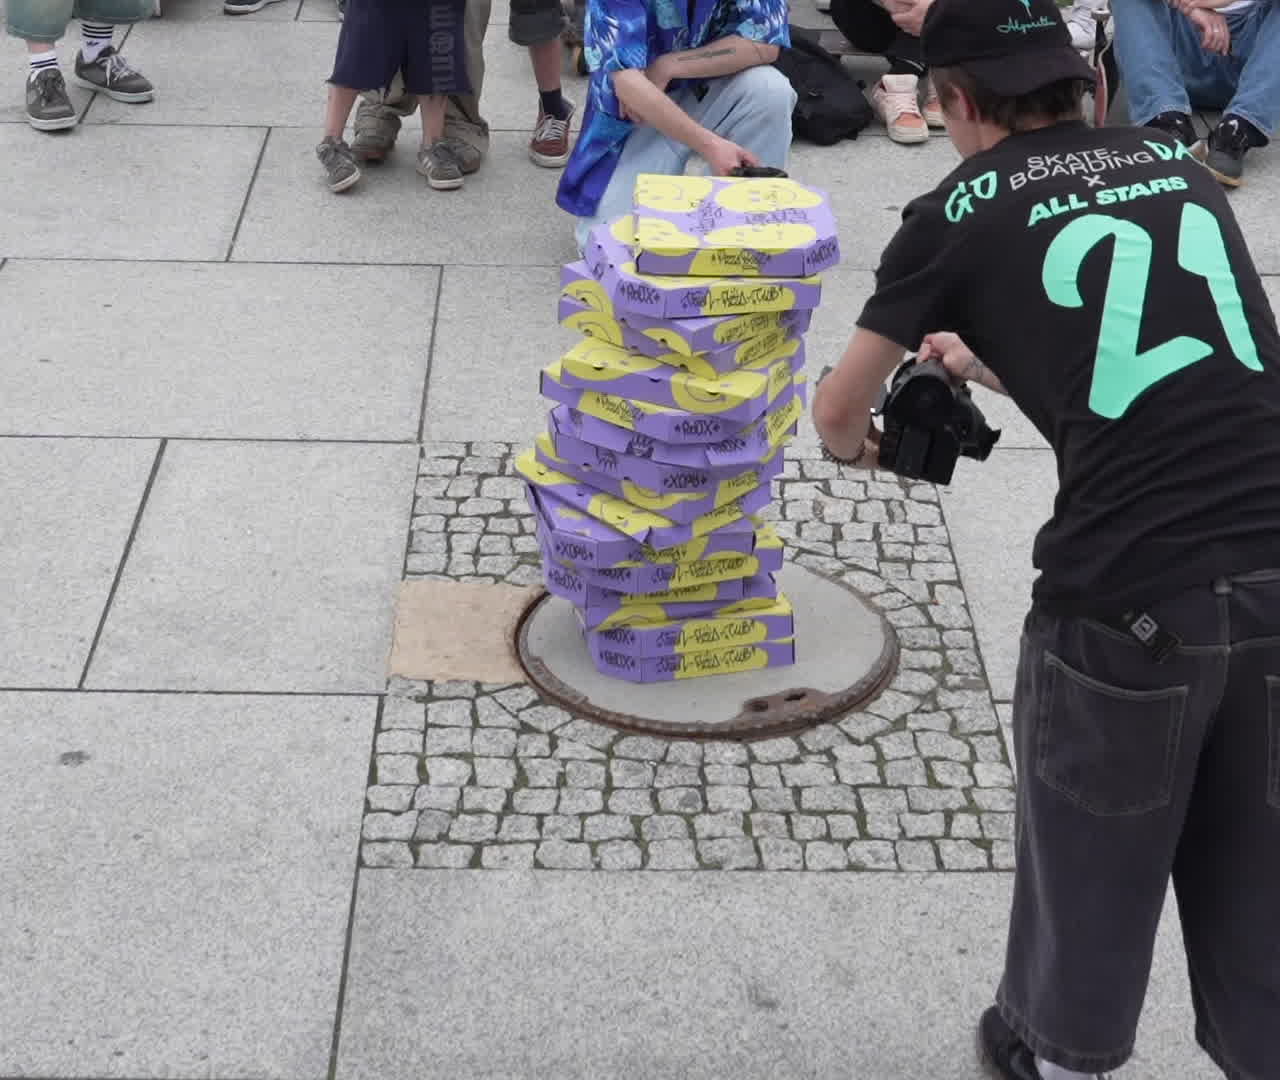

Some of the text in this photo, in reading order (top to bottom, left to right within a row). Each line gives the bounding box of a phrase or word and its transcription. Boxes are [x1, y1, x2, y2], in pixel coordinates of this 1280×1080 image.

[1009, 151, 1155, 191] BOARDING
[1027, 148, 1119, 169] SKATE-
[944, 170, 998, 223] GO
[1027, 176, 1189, 227] ALL STARS
[1041, 201, 1265, 420] 21
